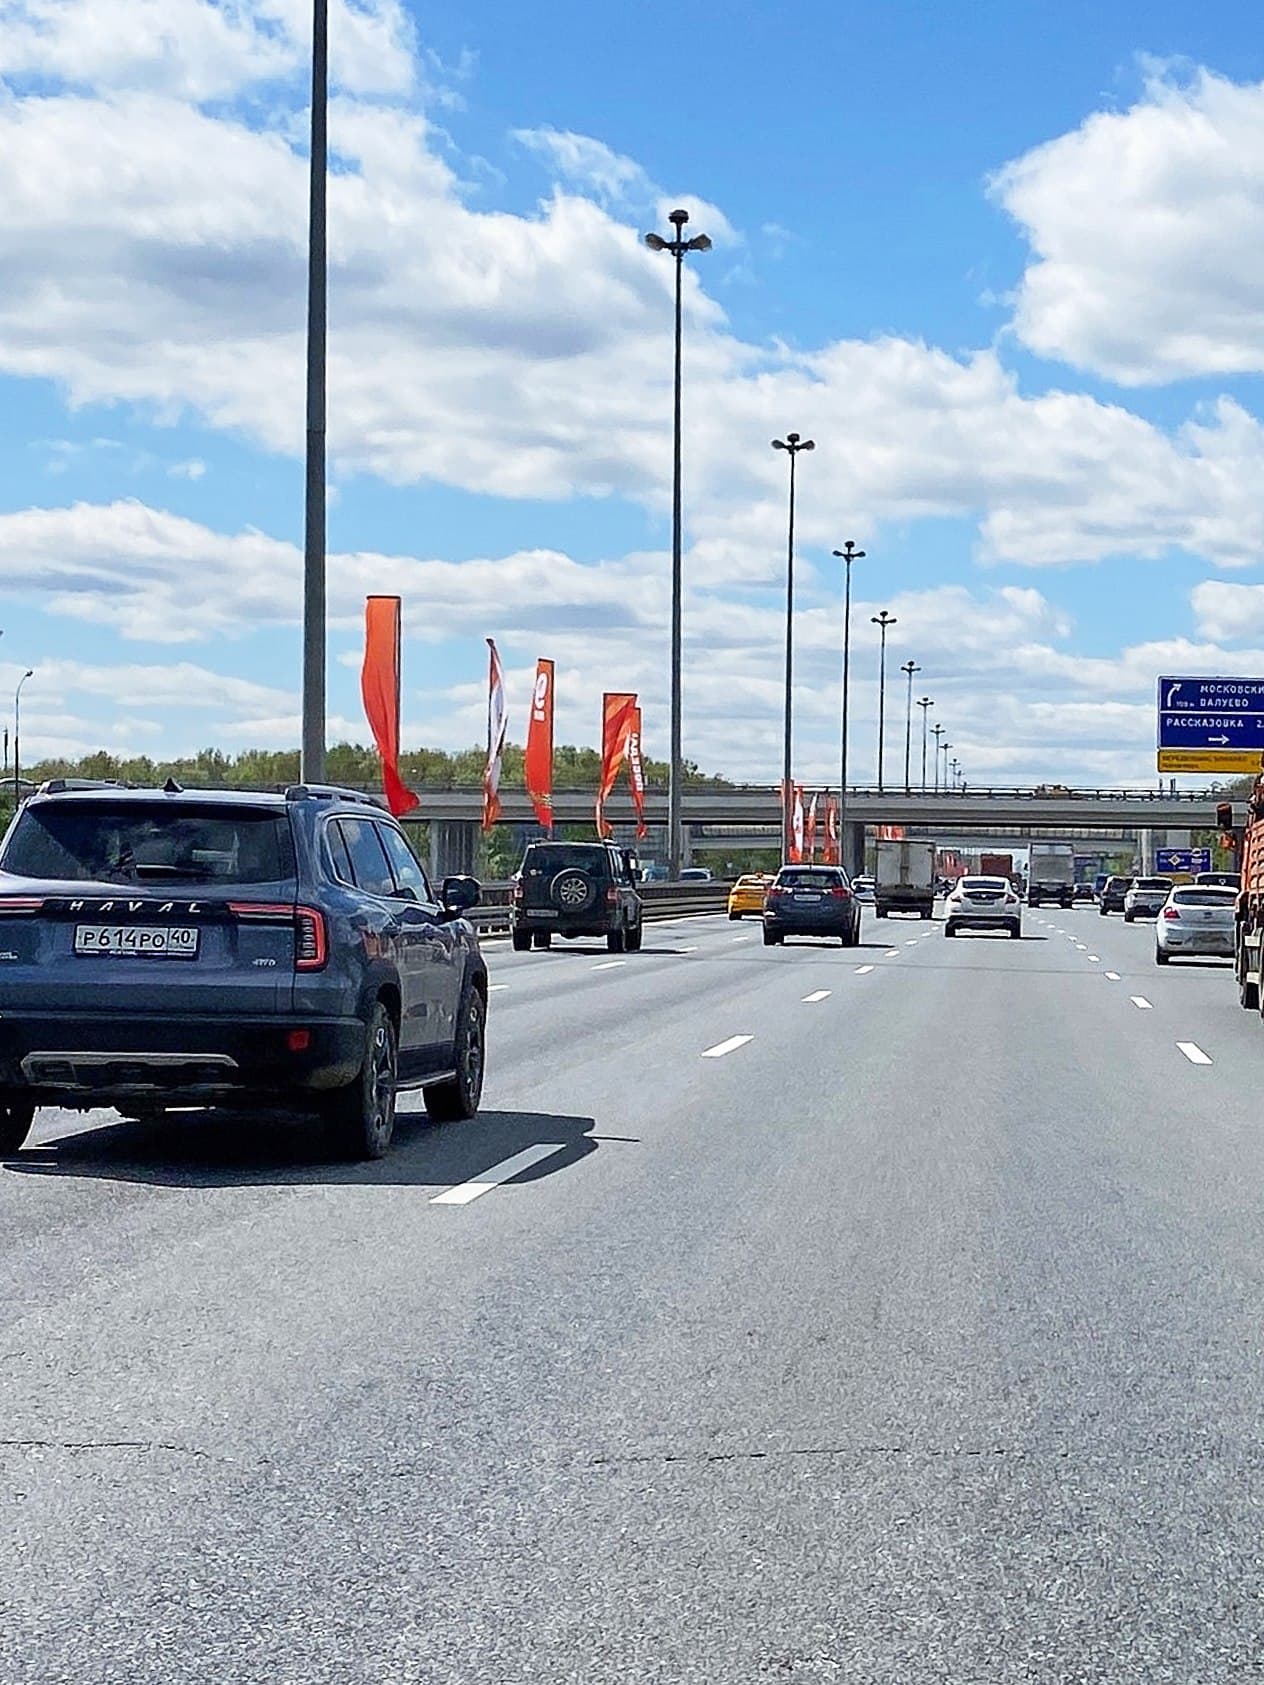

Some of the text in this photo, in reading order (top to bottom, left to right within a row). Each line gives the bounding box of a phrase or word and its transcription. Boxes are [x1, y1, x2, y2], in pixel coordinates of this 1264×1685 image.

[1199, 698, 1249, 708] ВАЛУЕВО
[1166, 718, 1245, 729] РАССКАЗОВКА
[69, 900, 201, 913] HAVAL
[83, 928, 192, 949] Р614РО 40
